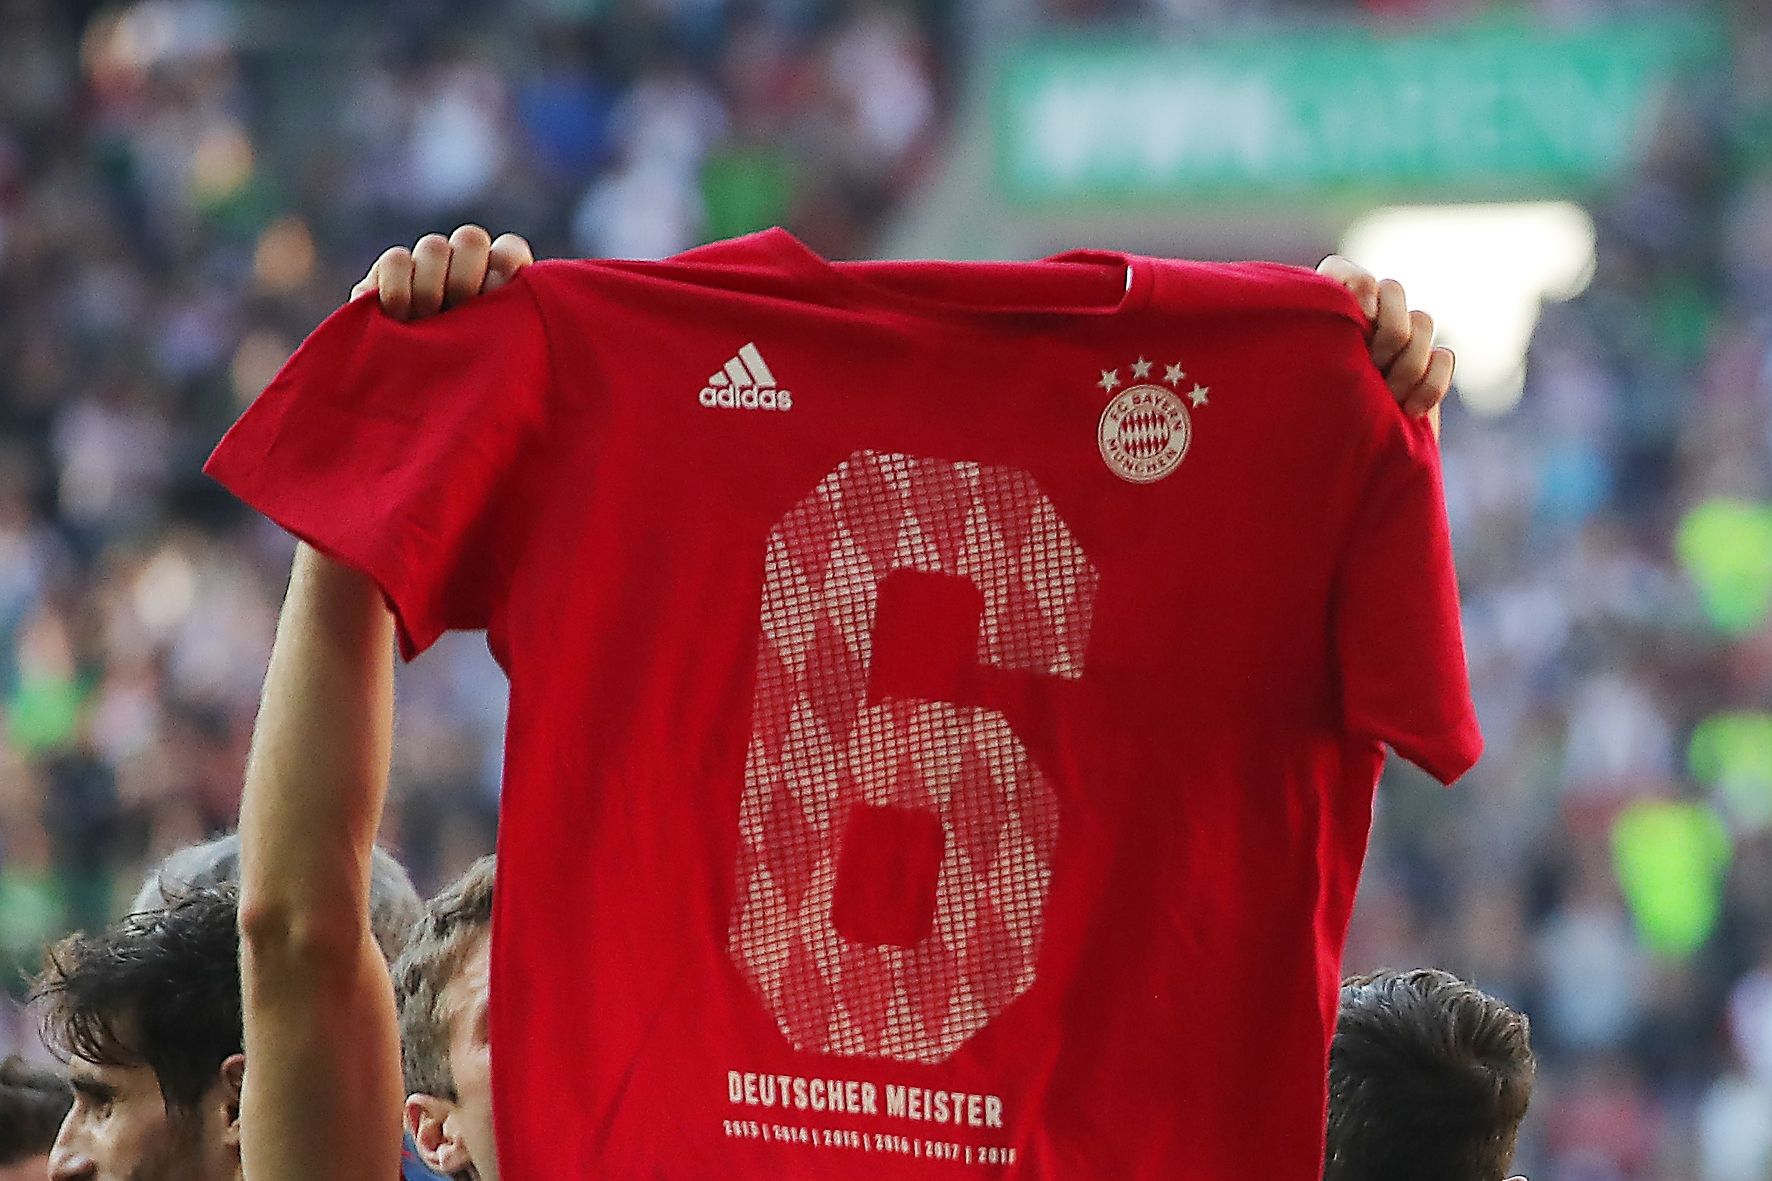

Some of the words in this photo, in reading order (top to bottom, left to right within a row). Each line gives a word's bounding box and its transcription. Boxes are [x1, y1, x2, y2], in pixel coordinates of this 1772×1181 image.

[699, 384, 793, 411] adidas
[727, 448, 1099, 1065] 6
[728, 1070, 877, 1115] DEUTSCHER
[885, 1084, 1003, 1129] MEISTER
